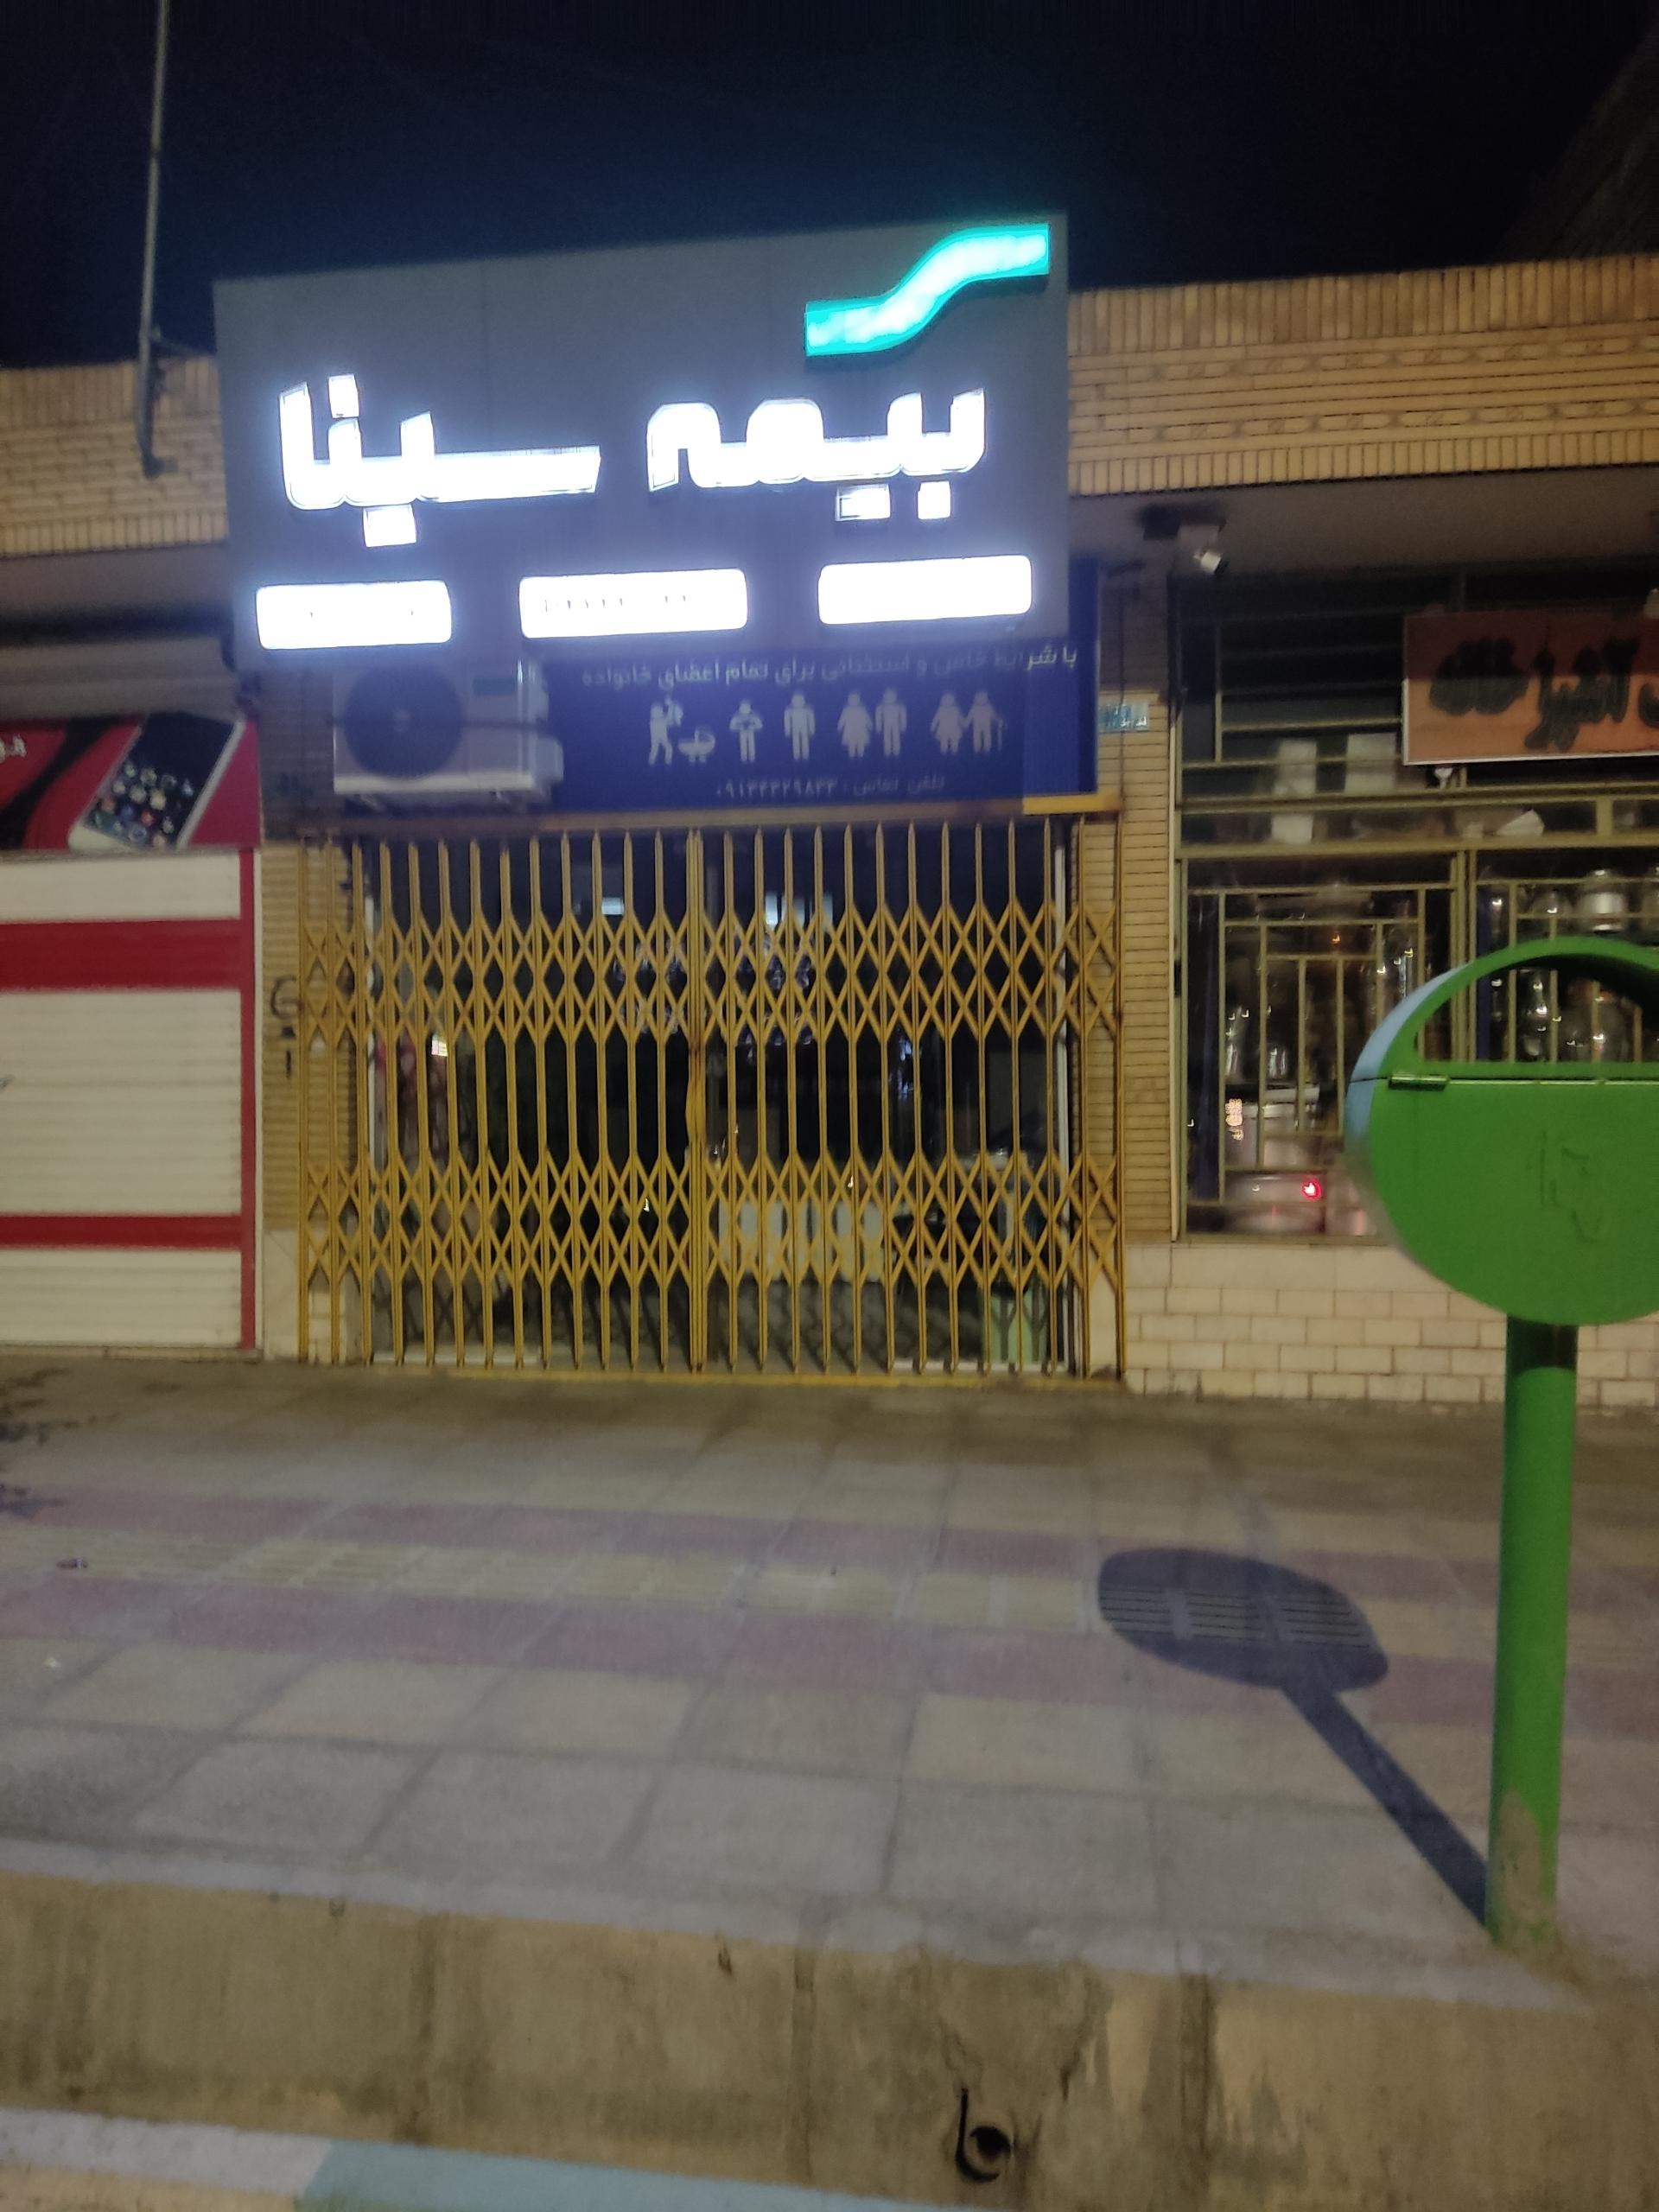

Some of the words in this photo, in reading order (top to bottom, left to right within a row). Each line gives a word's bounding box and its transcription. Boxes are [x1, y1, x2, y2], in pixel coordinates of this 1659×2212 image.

[277, 372, 601, 549] سینا
[646, 386, 986, 522] بیمه
[725, 658, 769, 685] تمام
[774, 655, 816, 683] برای
[1062, 645, 1077, 670] با
[582, 663, 652, 691] خانواده
[658, 660, 719, 690] اعضای
